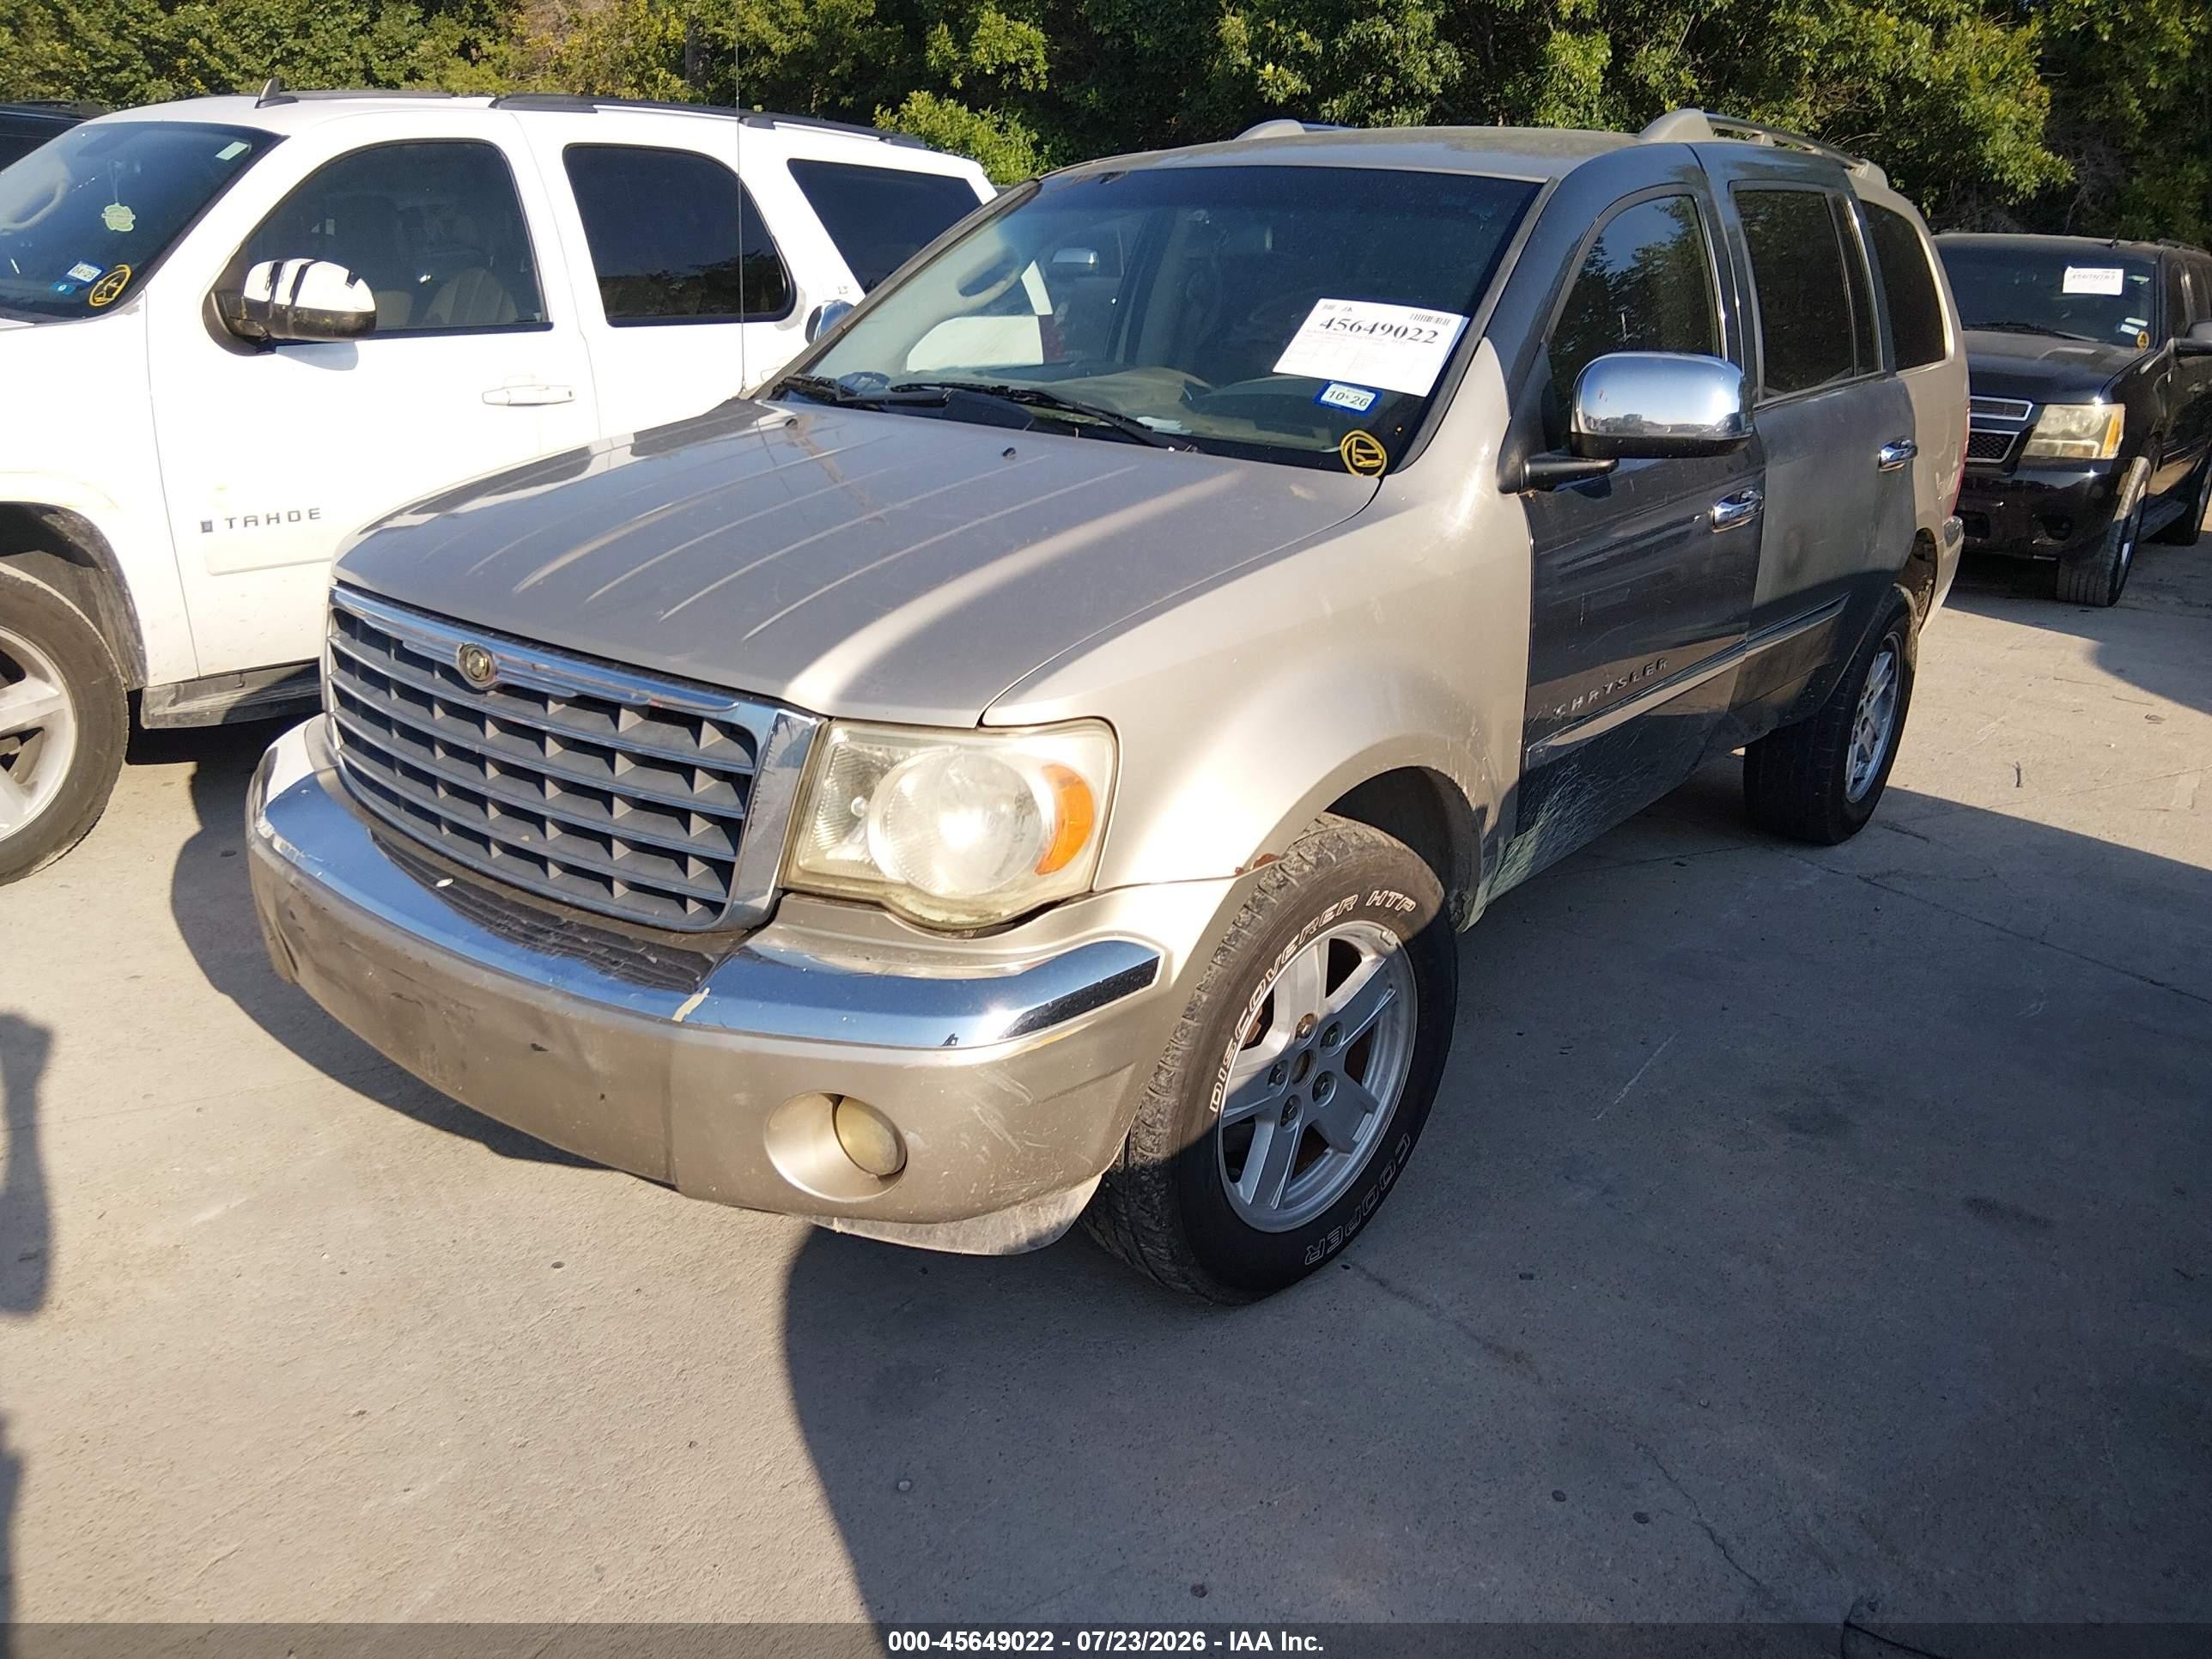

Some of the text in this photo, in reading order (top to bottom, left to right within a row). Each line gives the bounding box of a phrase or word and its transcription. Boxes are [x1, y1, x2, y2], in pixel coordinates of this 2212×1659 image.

[1319, 317, 1439, 344] 45649022
[224, 507, 321, 530] TAHOE
[1553, 658, 1668, 716] CHRYSLER
[1209, 890, 1417, 1114] DISCOVERER HTP
[1304, 1133, 1411, 1266] COOPER
